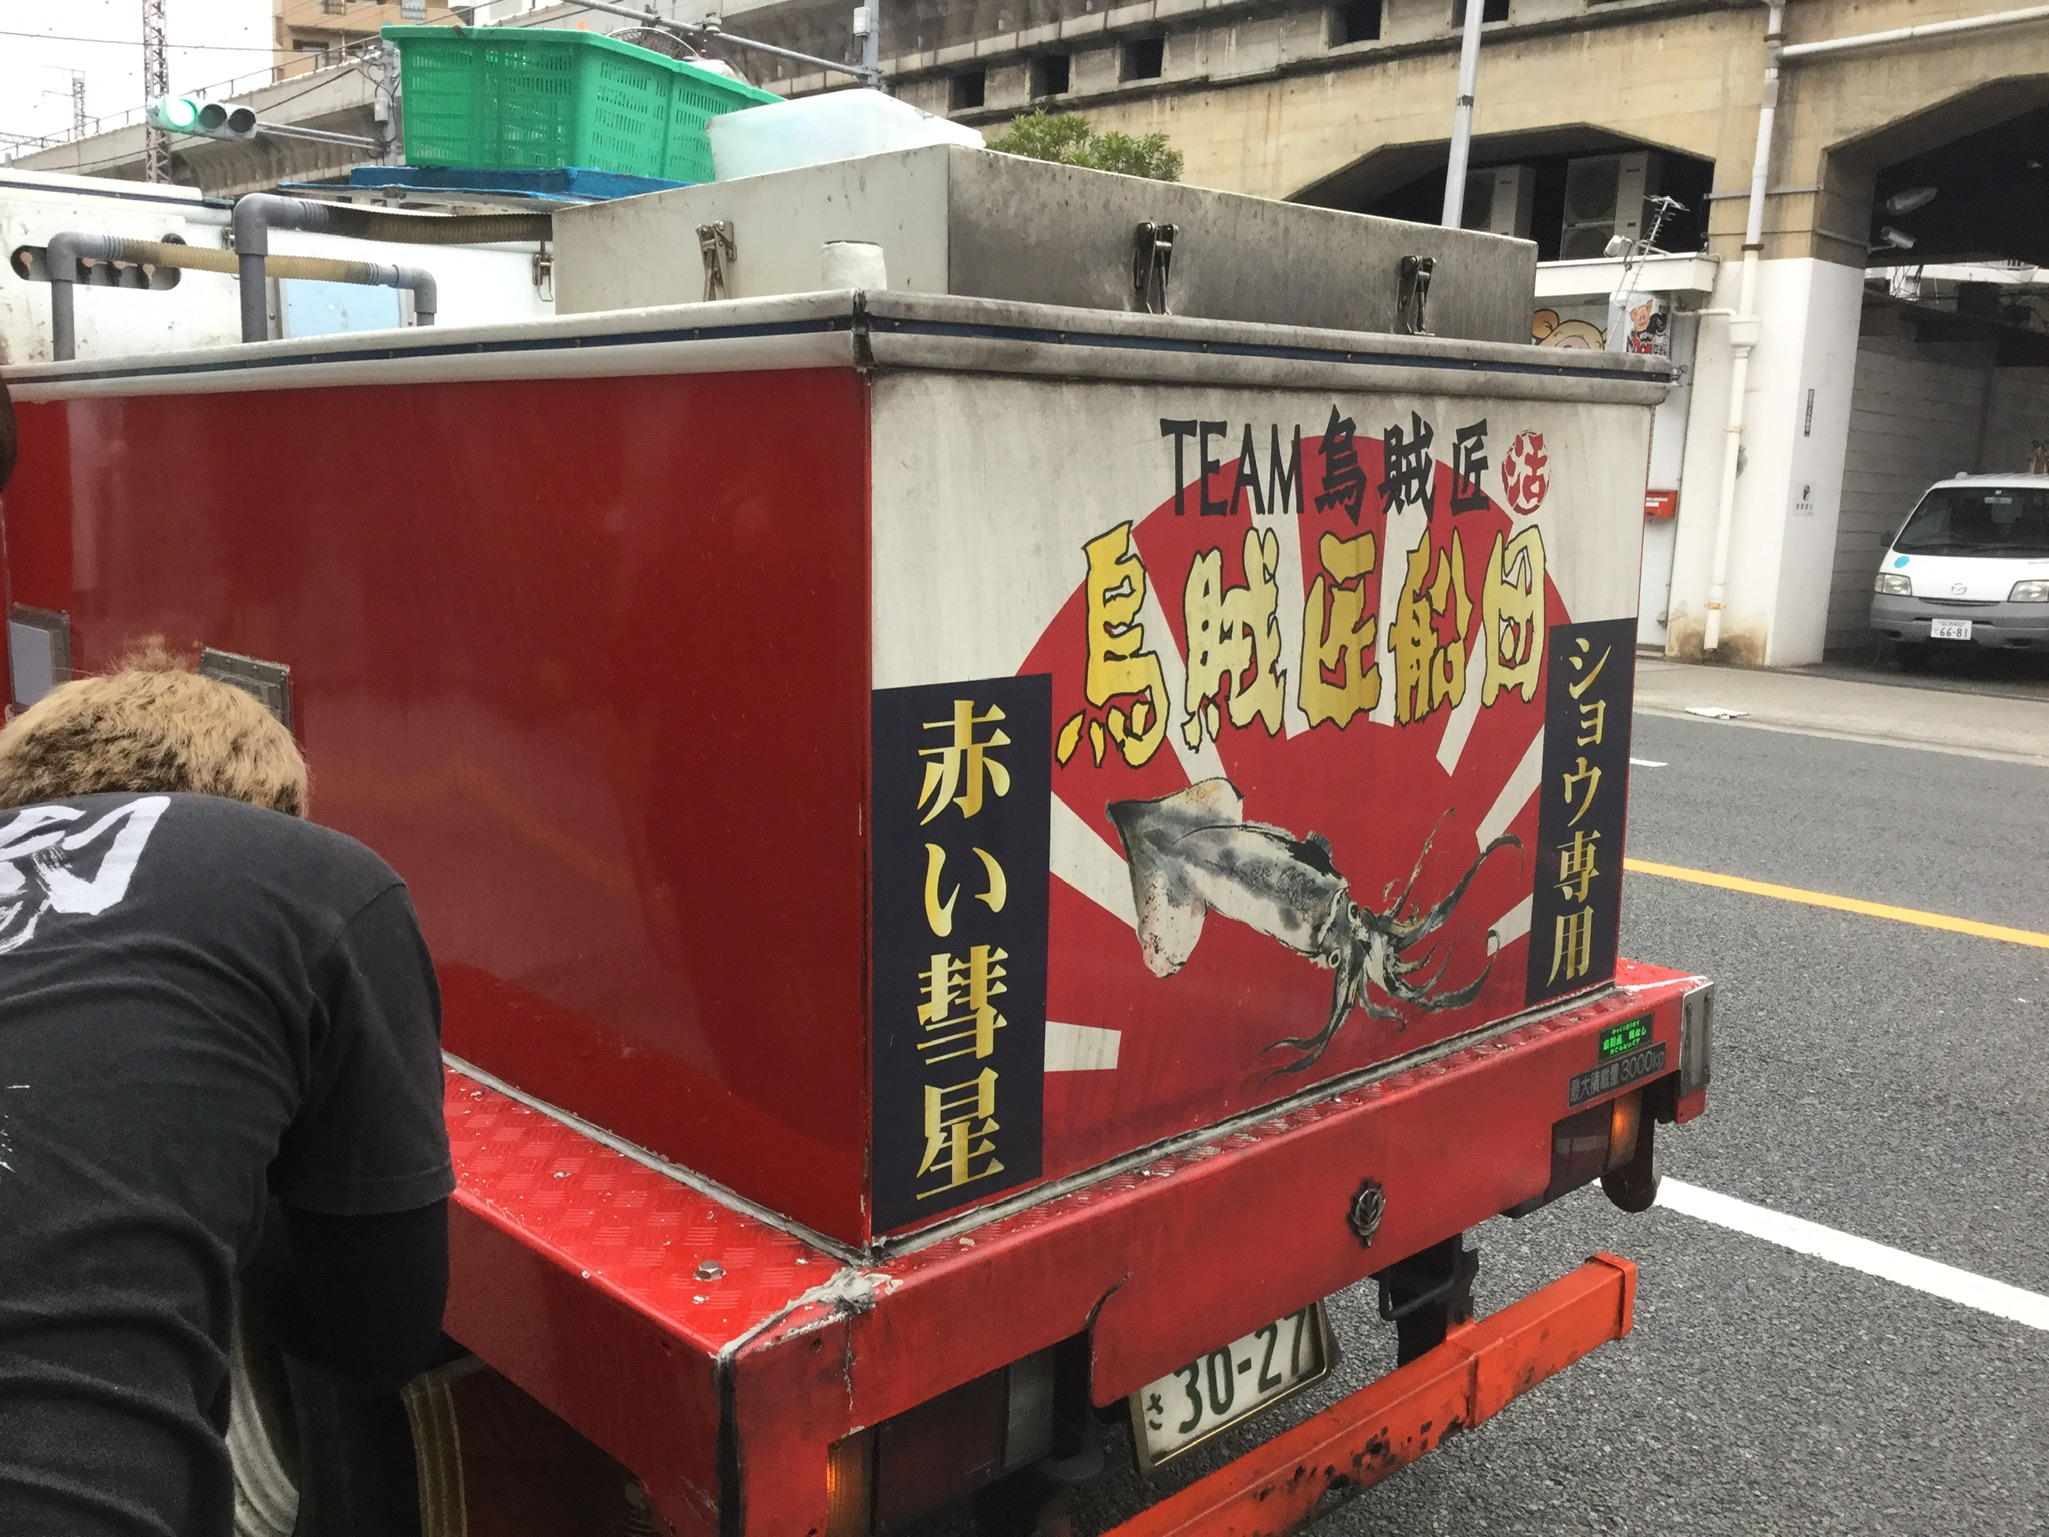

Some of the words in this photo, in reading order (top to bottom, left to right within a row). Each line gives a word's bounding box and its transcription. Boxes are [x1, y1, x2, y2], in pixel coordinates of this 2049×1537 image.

[1160, 417, 1305, 517] TEAM
[916, 700, 1011, 1200] 赤い彗星
[1547, 637, 1612, 988] ショウ専用
